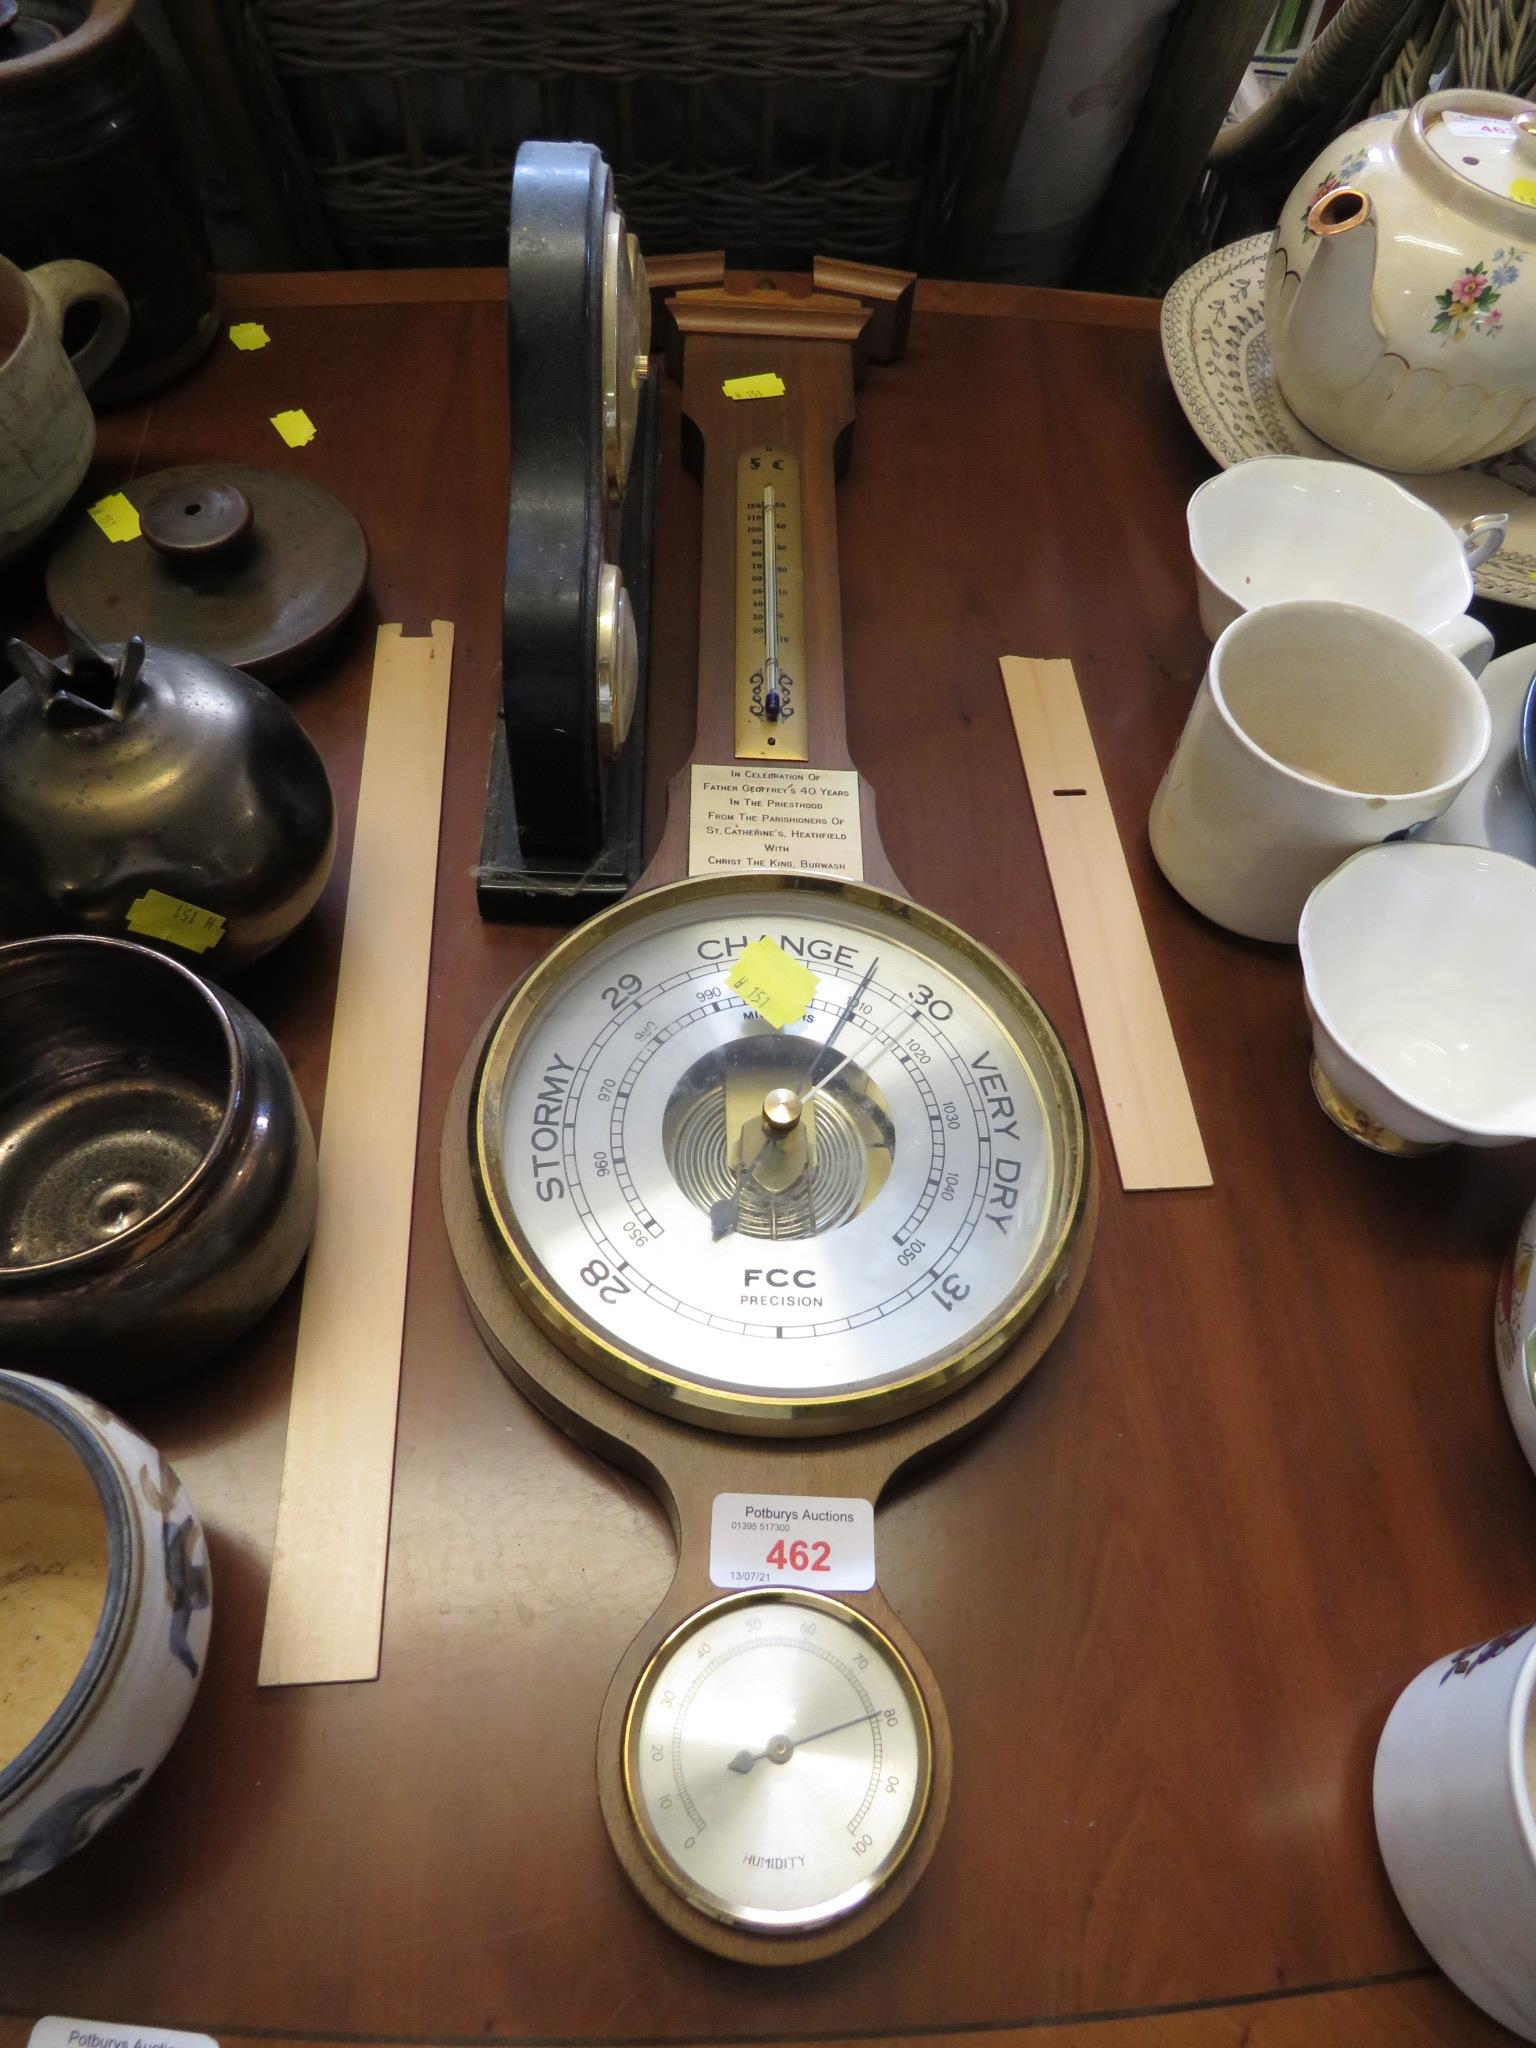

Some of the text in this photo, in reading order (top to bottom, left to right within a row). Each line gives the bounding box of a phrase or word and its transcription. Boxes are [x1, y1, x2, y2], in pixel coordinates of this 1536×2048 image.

[800, 786, 817, 795] 40
[697, 935, 859, 968] CHNGE
[601, 973, 643, 1010] 29
[696, 987, 722, 1003] 990
[748, 987, 771, 1008] 151
[905, 1038, 931, 1065] 1020
[598, 1078, 616, 1102] 970
[942, 1101, 961, 1130] 1030
[531, 1053, 575, 1202] STORMY
[972, 1050, 1022, 1235] VERY DRY
[593, 1151, 610, 1177] 960
[941, 1172, 959, 1201] 1040
[623, 1221, 648, 1247] 950
[898, 1238, 926, 1266] 1050
[580, 1259, 631, 1304] 28
[744, 1269, 816, 1288] FCC
[740, 1295, 823, 1307] PRECISION
[931, 1273, 970, 1312] 31
[745, 1506, 854, 1522] Potburys Auctions
[732, 1521, 790, 1532] 01395 517300
[766, 1539, 831, 1572] 462
[730, 1571, 770, 1582] 13/07/21
[746, 1619, 762, 1632] 50
[800, 1621, 816, 1636] 60
[697, 1642, 712, 1659] 40
[852, 1652, 869, 1671] 70
[661, 1690, 676, 1709] 30
[884, 1708, 898, 1727] 80
[652, 1745, 664, 1762] 20
[886, 1775, 899, 1794] 90
[658, 1794, 673, 1810] 10
[684, 1836, 696, 1849] 0
[852, 1834, 873, 1856] 100
[743, 1854, 806, 1870] HUMIDITY
